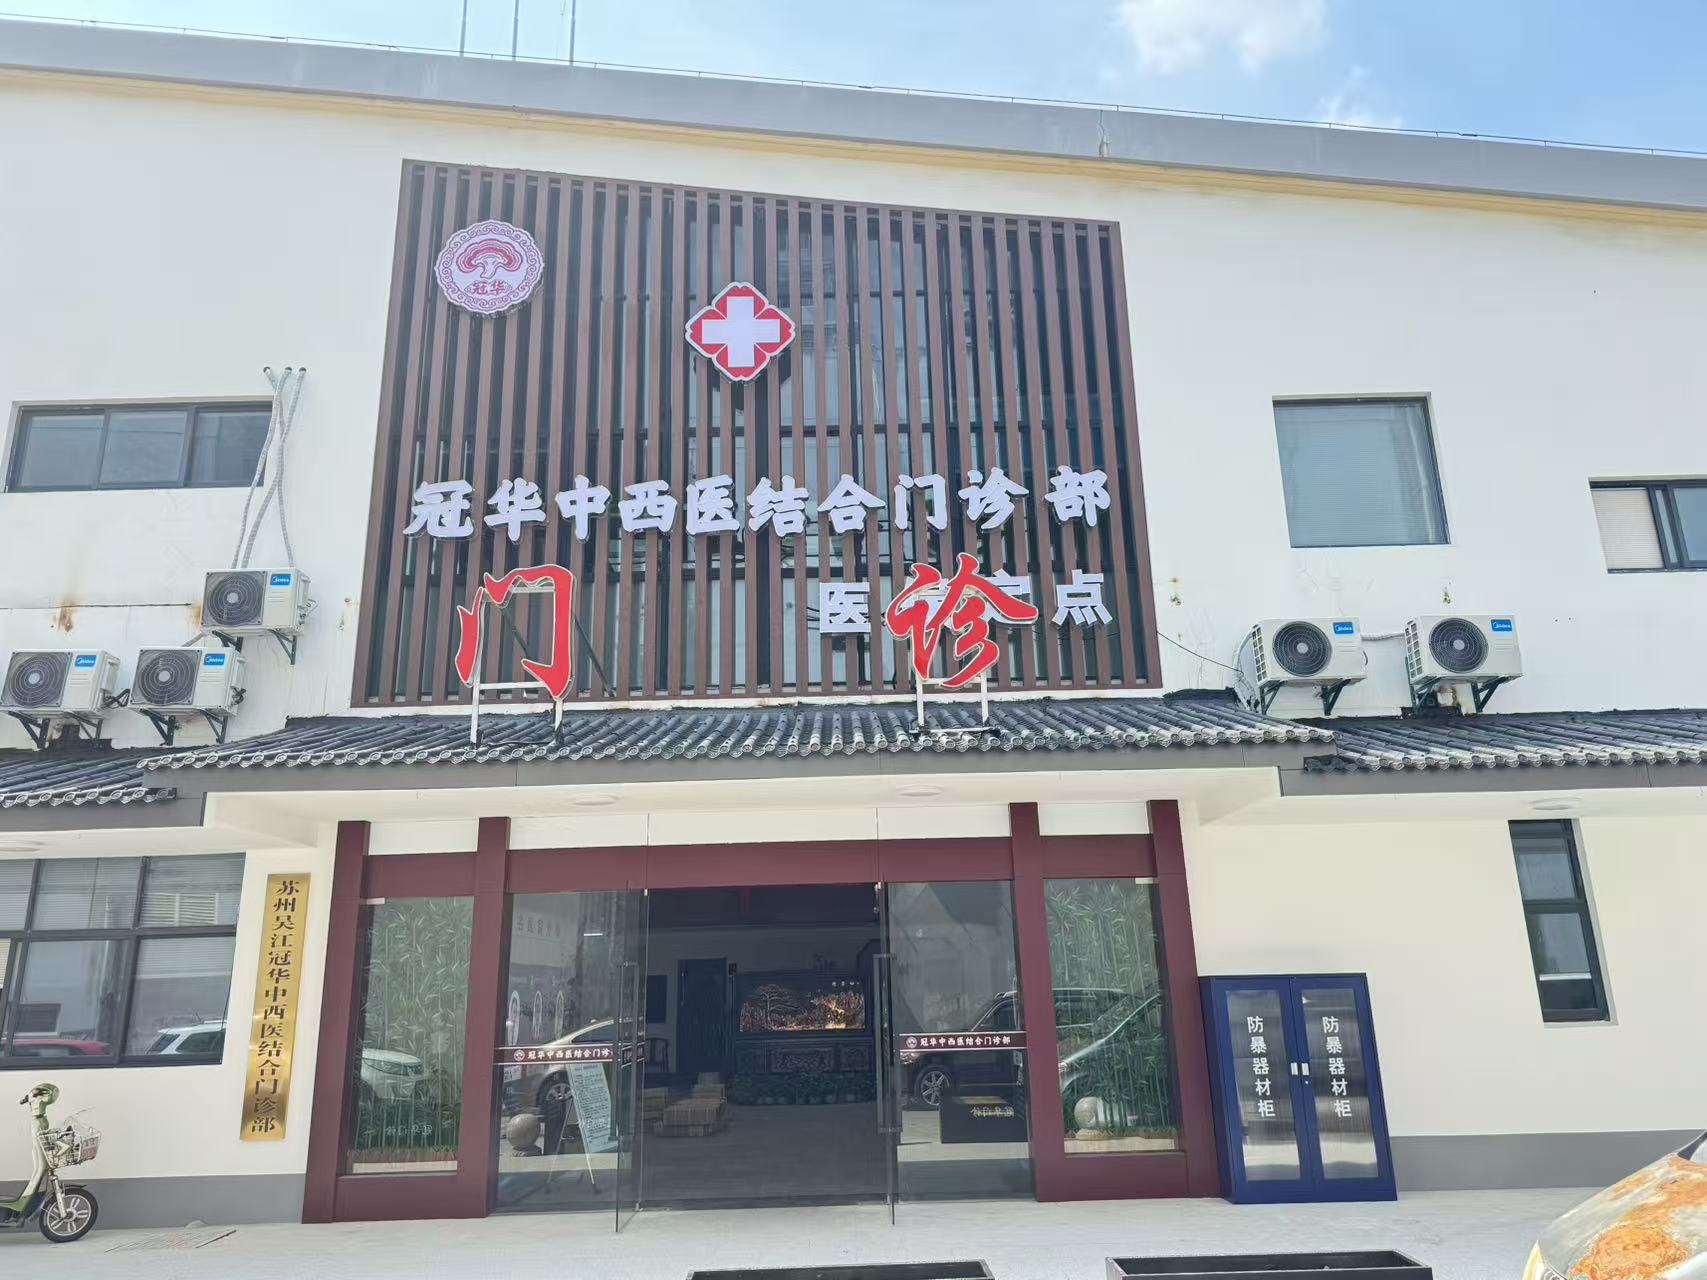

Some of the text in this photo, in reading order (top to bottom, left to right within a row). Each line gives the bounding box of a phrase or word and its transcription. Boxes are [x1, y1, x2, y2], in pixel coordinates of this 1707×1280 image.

[472, 280, 506, 295] 冠华
[402, 465, 1112, 542] 冠华中西医结合门诊部
[251, 880, 300, 1134] 苏州吴江冠华中西医结合门诊部
[919, 1036, 1011, 1048] 冠华中西医结合门诊部
[527, 1047, 613, 1060] 冠华中西医结合门诊
[1247, 1016, 1275, 1118] 防暴器材柜
[1322, 1016, 1352, 1118] 防暴器材柜
